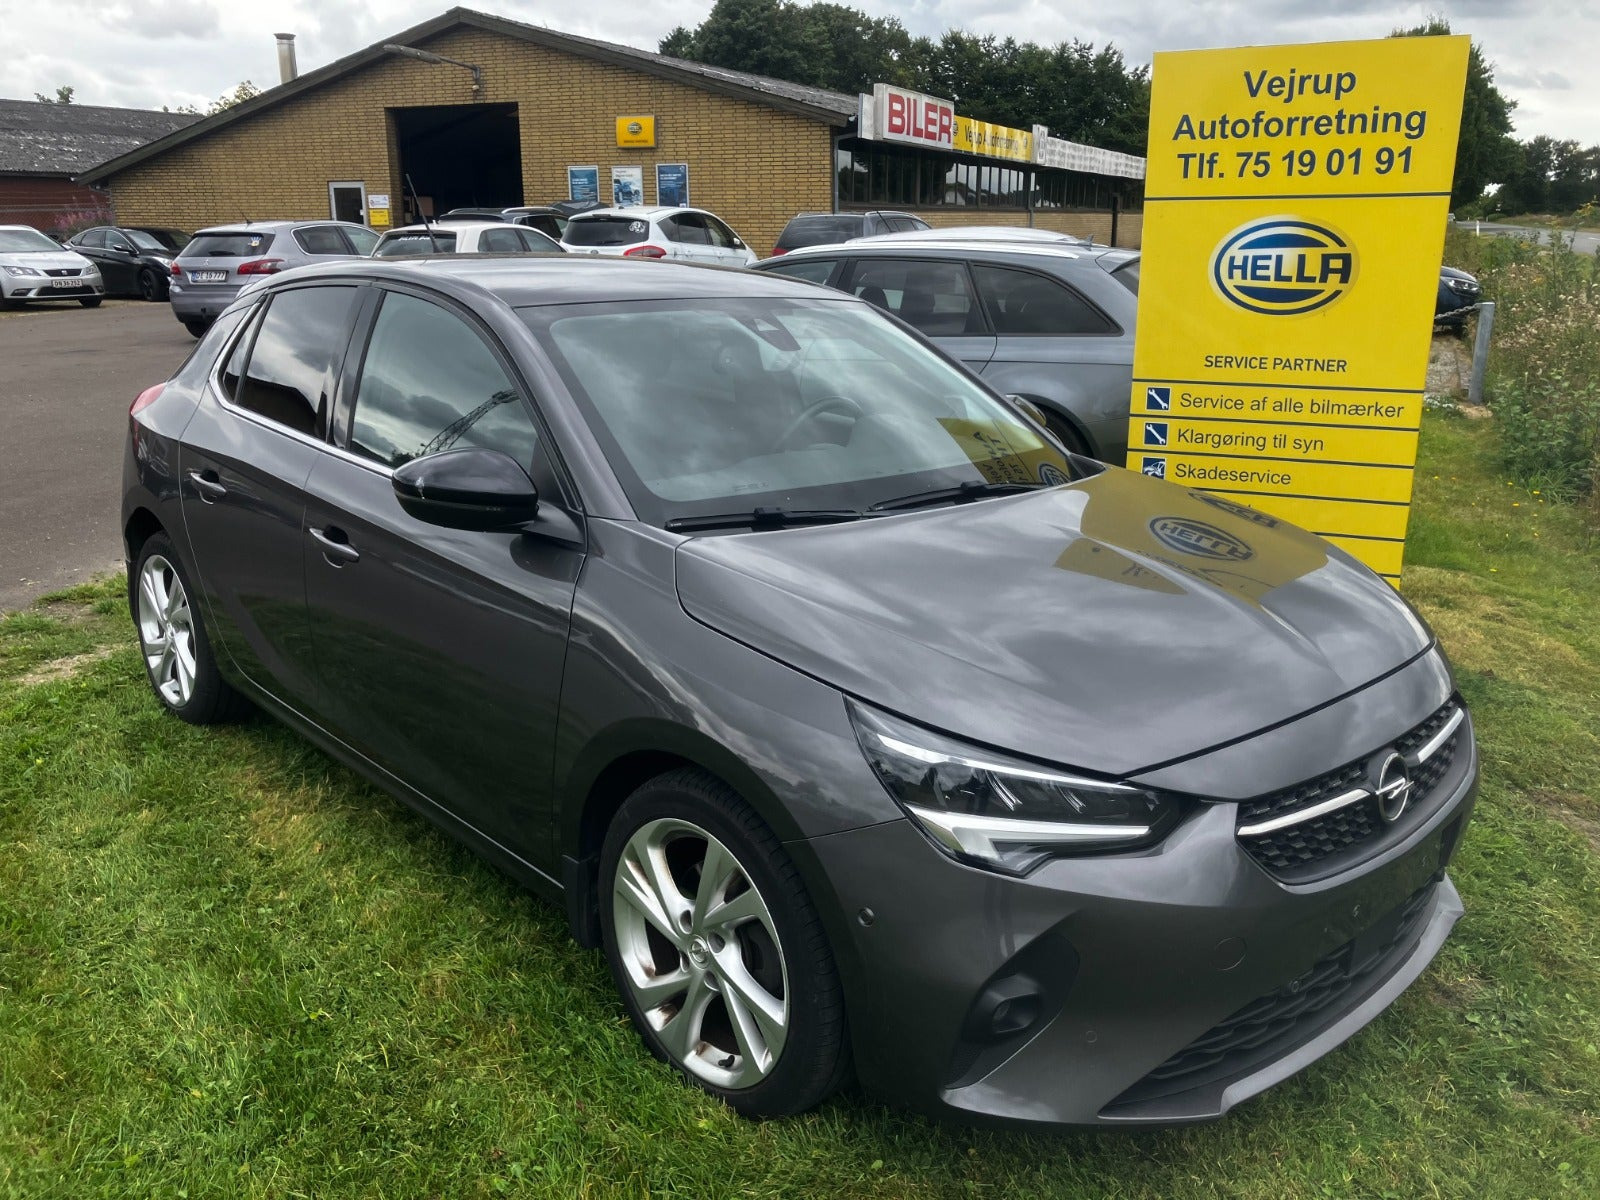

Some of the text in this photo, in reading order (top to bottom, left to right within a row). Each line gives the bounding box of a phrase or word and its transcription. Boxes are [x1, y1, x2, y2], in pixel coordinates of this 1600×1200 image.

[1243, 69, 1357, 103] Vejrup
[888, 93, 952, 144] BILER
[1172, 106, 1427, 141] Autoforretning
[1177, 152, 1225, 179] Tlf.
[1236, 151, 1271, 178] 75
[1282, 149, 1316, 177] 19
[1326, 147, 1362, 176] 01
[1375, 146, 1413, 175] 91
[1228, 253, 1352, 284] HELLA
[1204, 355, 1347, 372] SERVICE PARTNER
[1180, 393, 1404, 418] Service af alle bilmærker
[1178, 429, 1324, 454] Klargøring til syn
[1175, 464, 1291, 485] Skadeservice
